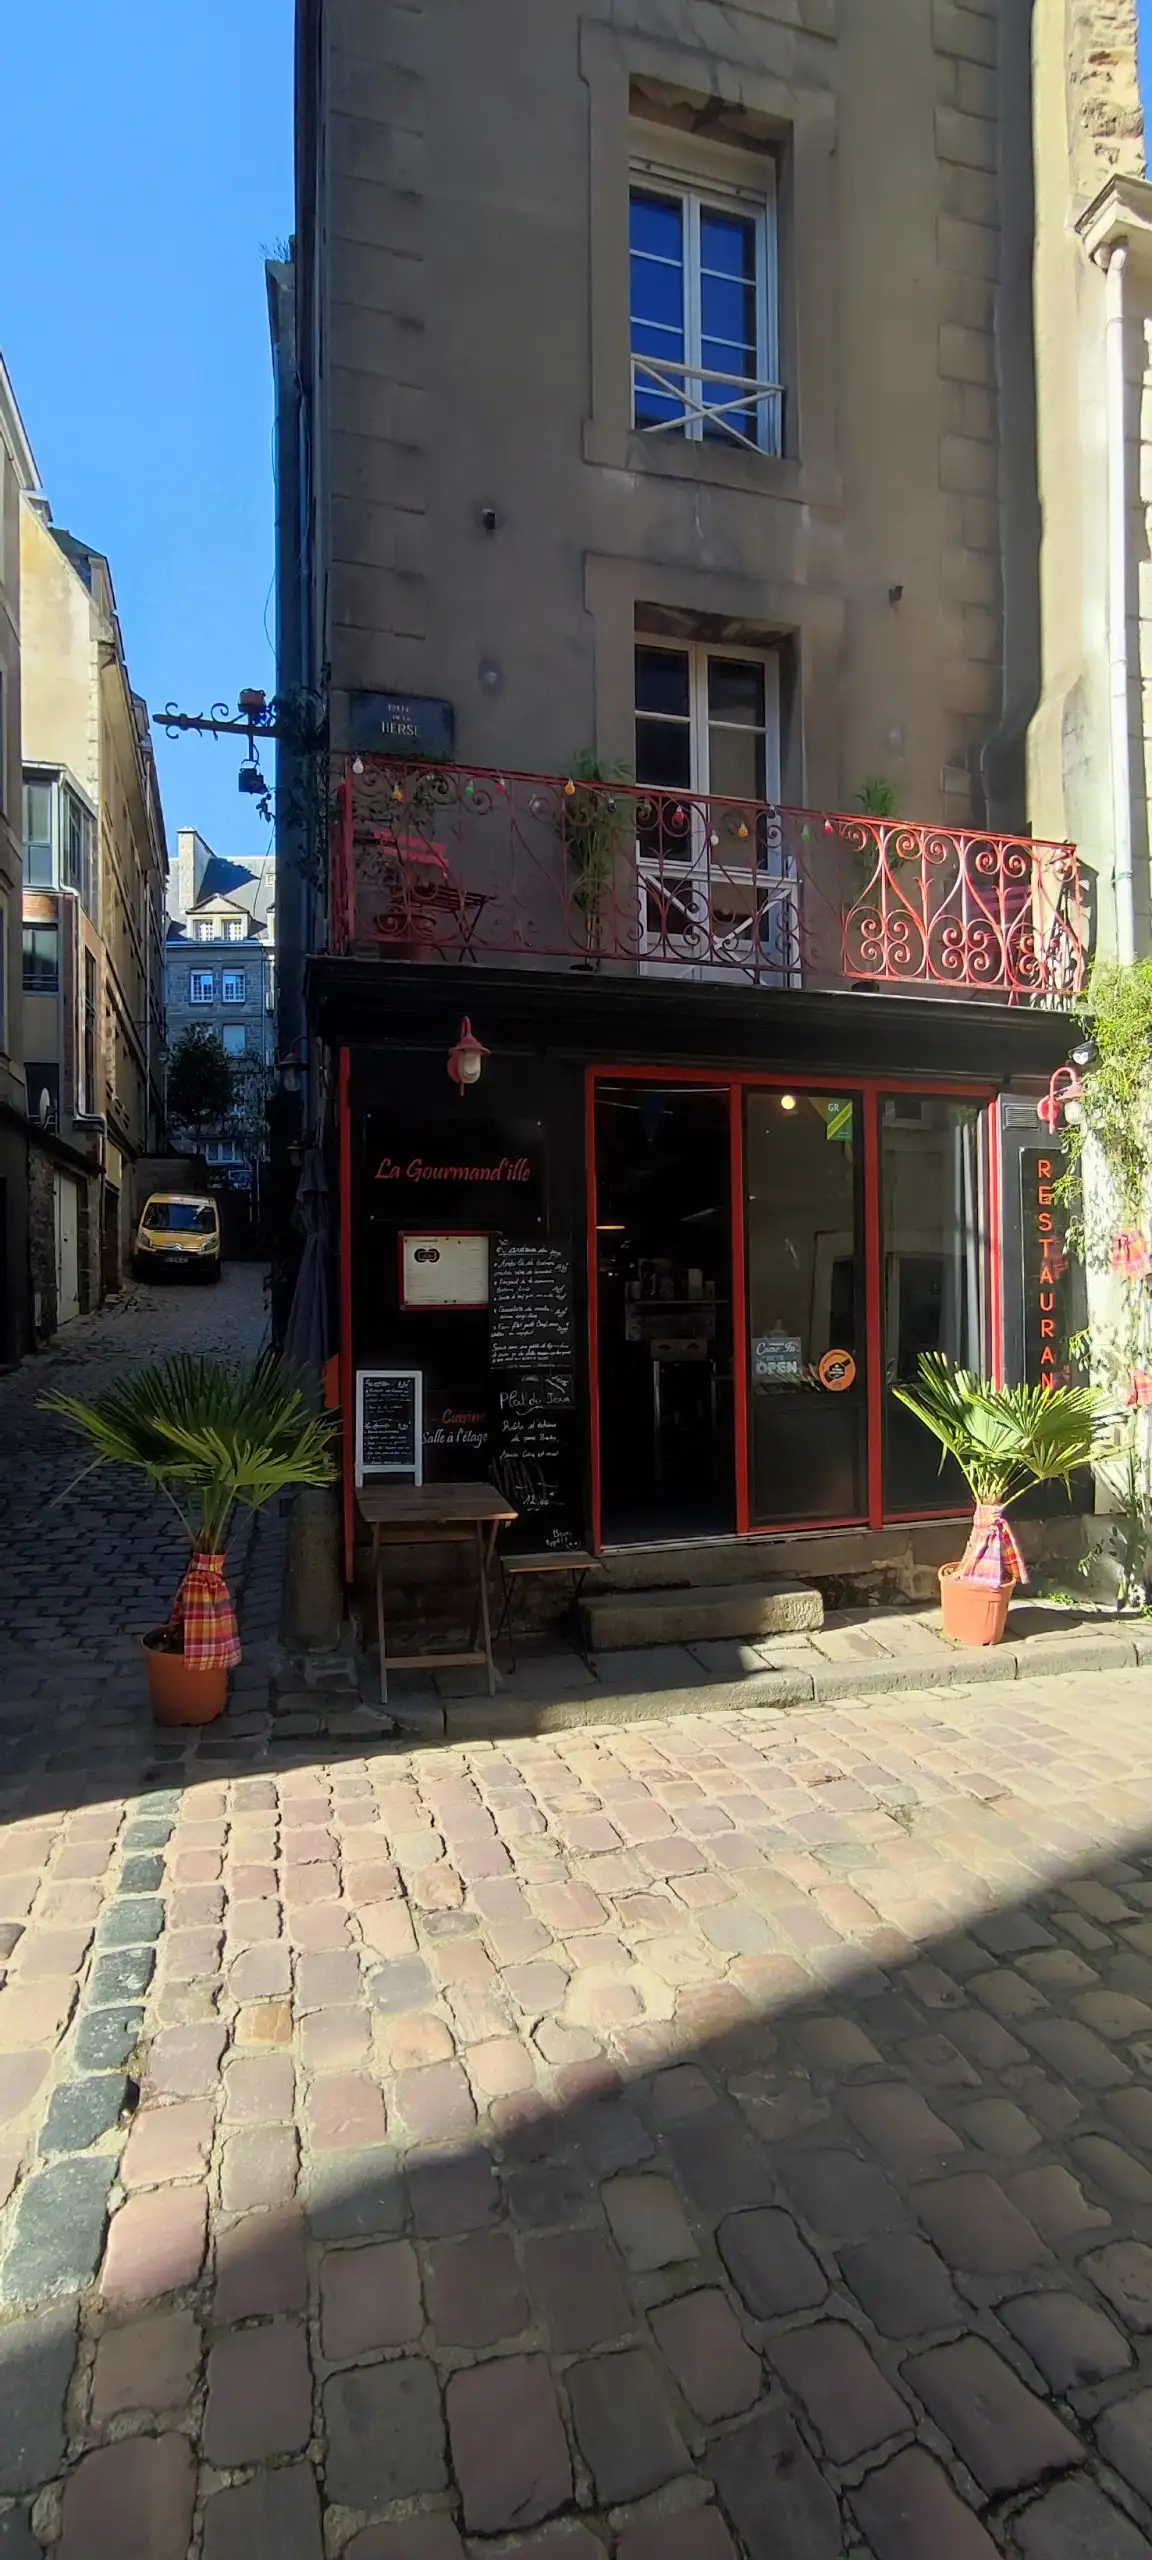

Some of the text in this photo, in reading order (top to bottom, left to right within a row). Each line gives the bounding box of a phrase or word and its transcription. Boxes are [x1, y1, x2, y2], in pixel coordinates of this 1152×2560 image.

[381, 720, 421, 739] HERSE
[374, 1157, 531, 1183] La Gourmand'ille
[1037, 1158, 1056, 1403] RESTAURAN
[756, 1342, 781, 1356] Come
[756, 1361, 798, 1375] OPEN
[500, 1390, 525, 1410] Plat
[528, 1392, 542, 1406] du
[422, 1428, 488, 1449] Salle à l'étage
